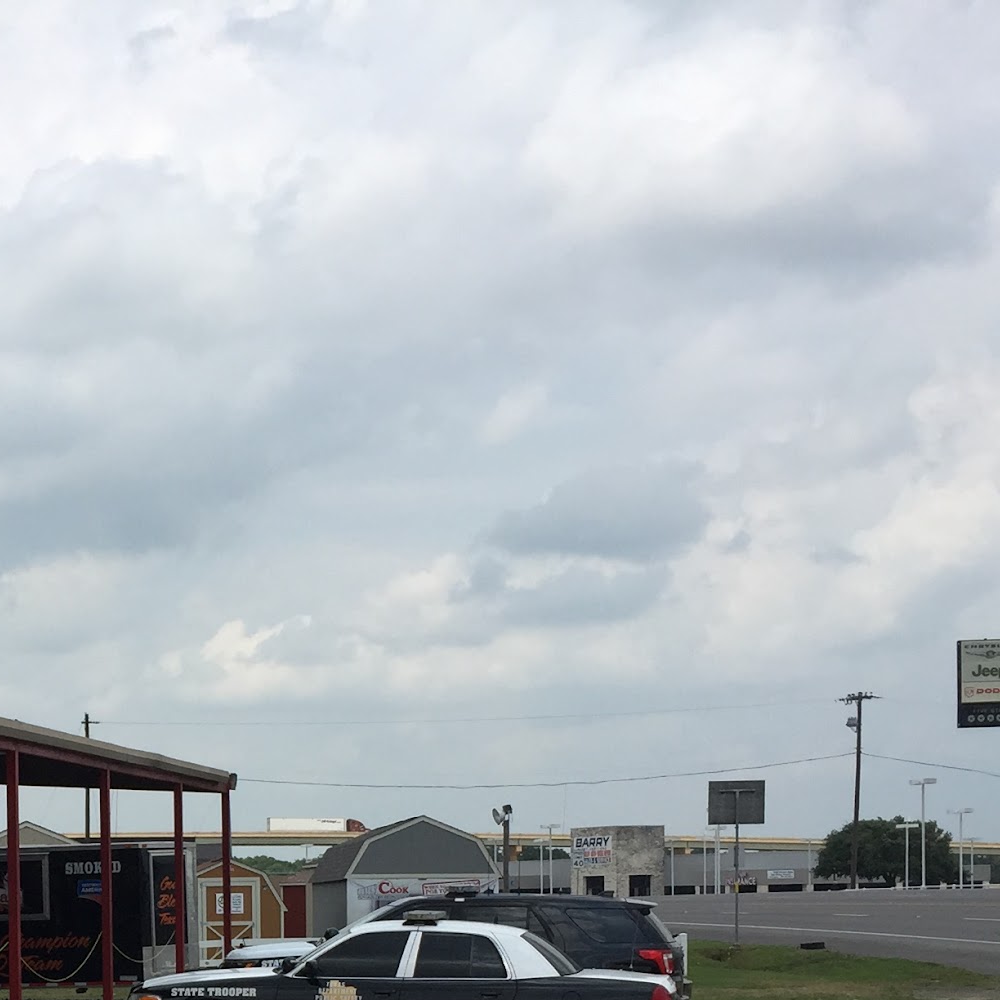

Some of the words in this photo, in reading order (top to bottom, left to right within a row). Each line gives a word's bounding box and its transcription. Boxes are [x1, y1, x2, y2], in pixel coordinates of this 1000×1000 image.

[972, 664, 1000, 679] Jee
[575, 836, 610, 848] BARRY
[65, 860, 122, 876] SMOKD
[171, 987, 205, 997] STATE
[207, 987, 258, 997] TROOPER
